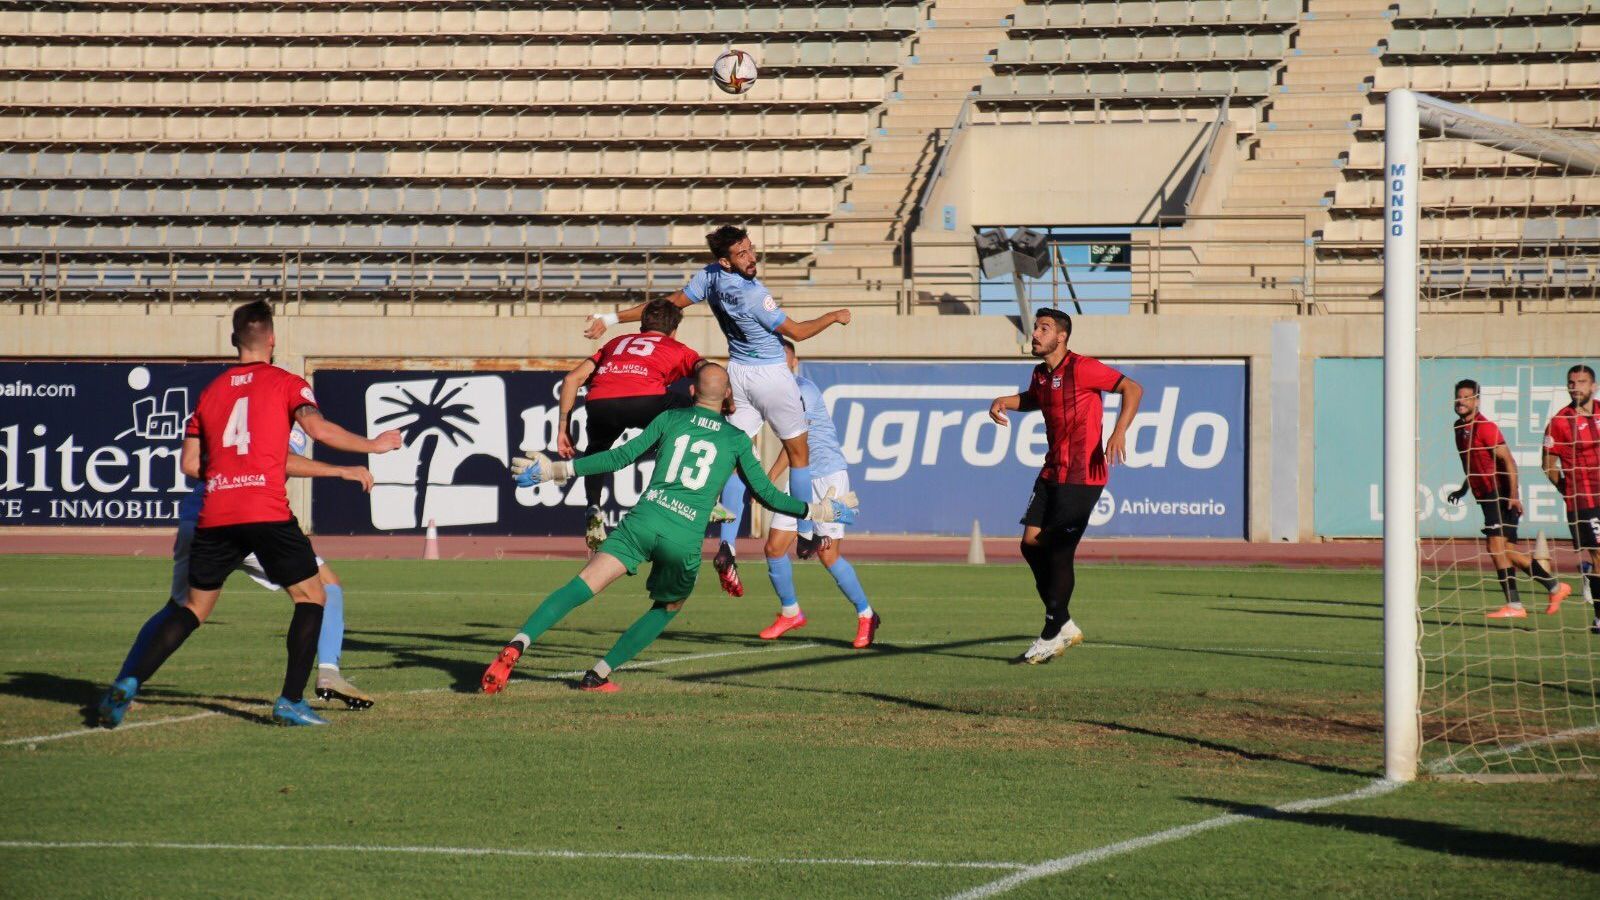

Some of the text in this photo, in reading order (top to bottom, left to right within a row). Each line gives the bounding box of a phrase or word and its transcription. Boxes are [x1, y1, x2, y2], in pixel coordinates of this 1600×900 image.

[1391, 164, 1406, 236] MONDO
[613, 336, 662, 356] 15
[222, 396, 251, 455] 4
[664, 434, 718, 491] 13
[49, 500, 181, 518] INMOBILI
[1120, 498, 1226, 515] Aniversario
